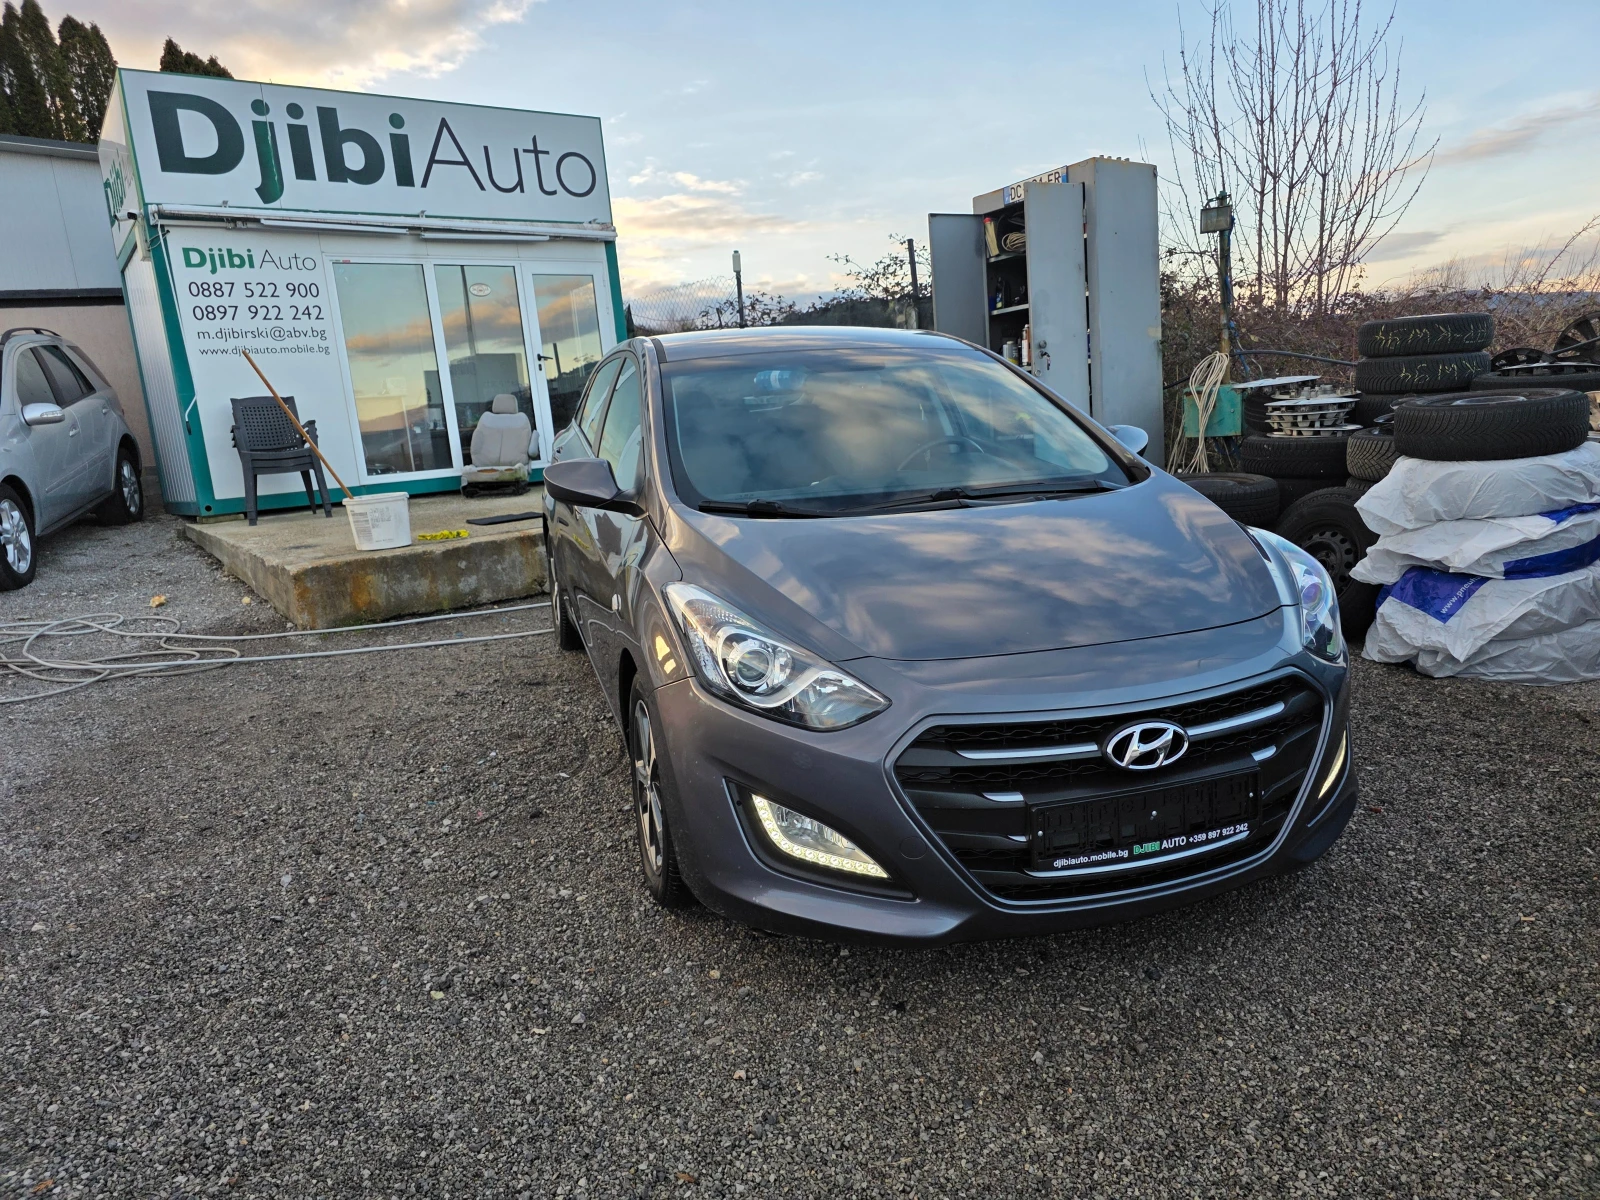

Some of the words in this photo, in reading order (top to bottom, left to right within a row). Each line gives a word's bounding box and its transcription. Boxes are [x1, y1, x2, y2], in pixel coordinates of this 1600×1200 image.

[182, 247, 255, 274] Djibi
[259, 249, 317, 271] Auto
[188, 281, 235, 298] 0887
[244, 282, 280, 298] 522
[285, 282, 320, 299] 900
[192, 305, 239, 321] 0897
[247, 305, 284, 321] 922
[289, 305, 325, 321] 242
[197, 326, 327, 342] m.djibirski@abv.bg
[199, 344, 330, 356] www.djibiauto.mobile.bg
[1053, 850, 1129, 868] djibiauto.mobile.bg
[1161, 836, 1187, 850] AUTO
[1188, 832, 1207, 843] +359
[1207, 830, 1222, 840] 897
[1221, 827, 1235, 837] 922
[1235, 823, 1249, 833] 242
